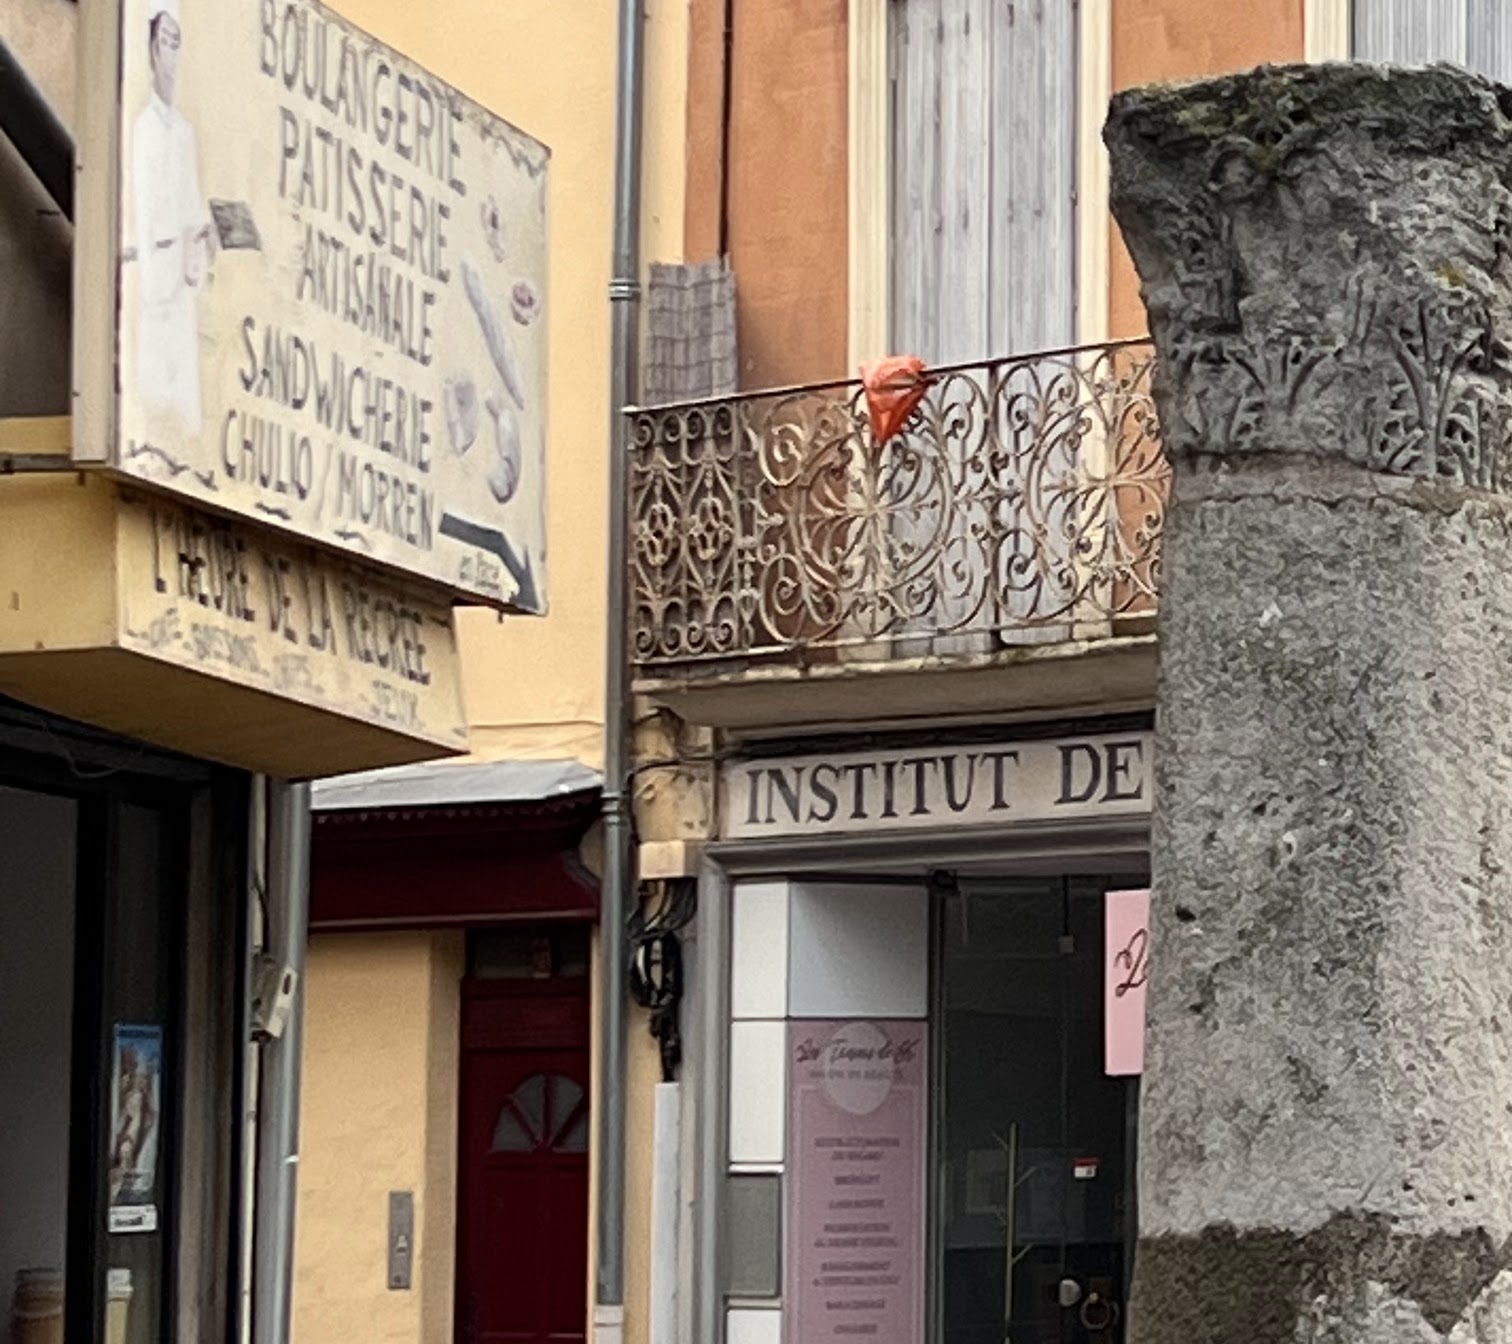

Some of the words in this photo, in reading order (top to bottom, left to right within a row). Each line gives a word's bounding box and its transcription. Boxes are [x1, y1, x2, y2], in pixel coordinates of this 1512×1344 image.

[278, 105, 450, 284] PATISSERIE
[295, 222, 435, 367] ARTISANALE
[238, 315, 433, 474] SANDWICHERIE
[334, 450, 435, 552] MORREN
[262, 552, 299, 646] DE
[302, 559, 339, 657] LA
[744, 749, 1020, 827] INSTITUT
[1052, 739, 1144, 806] DE
